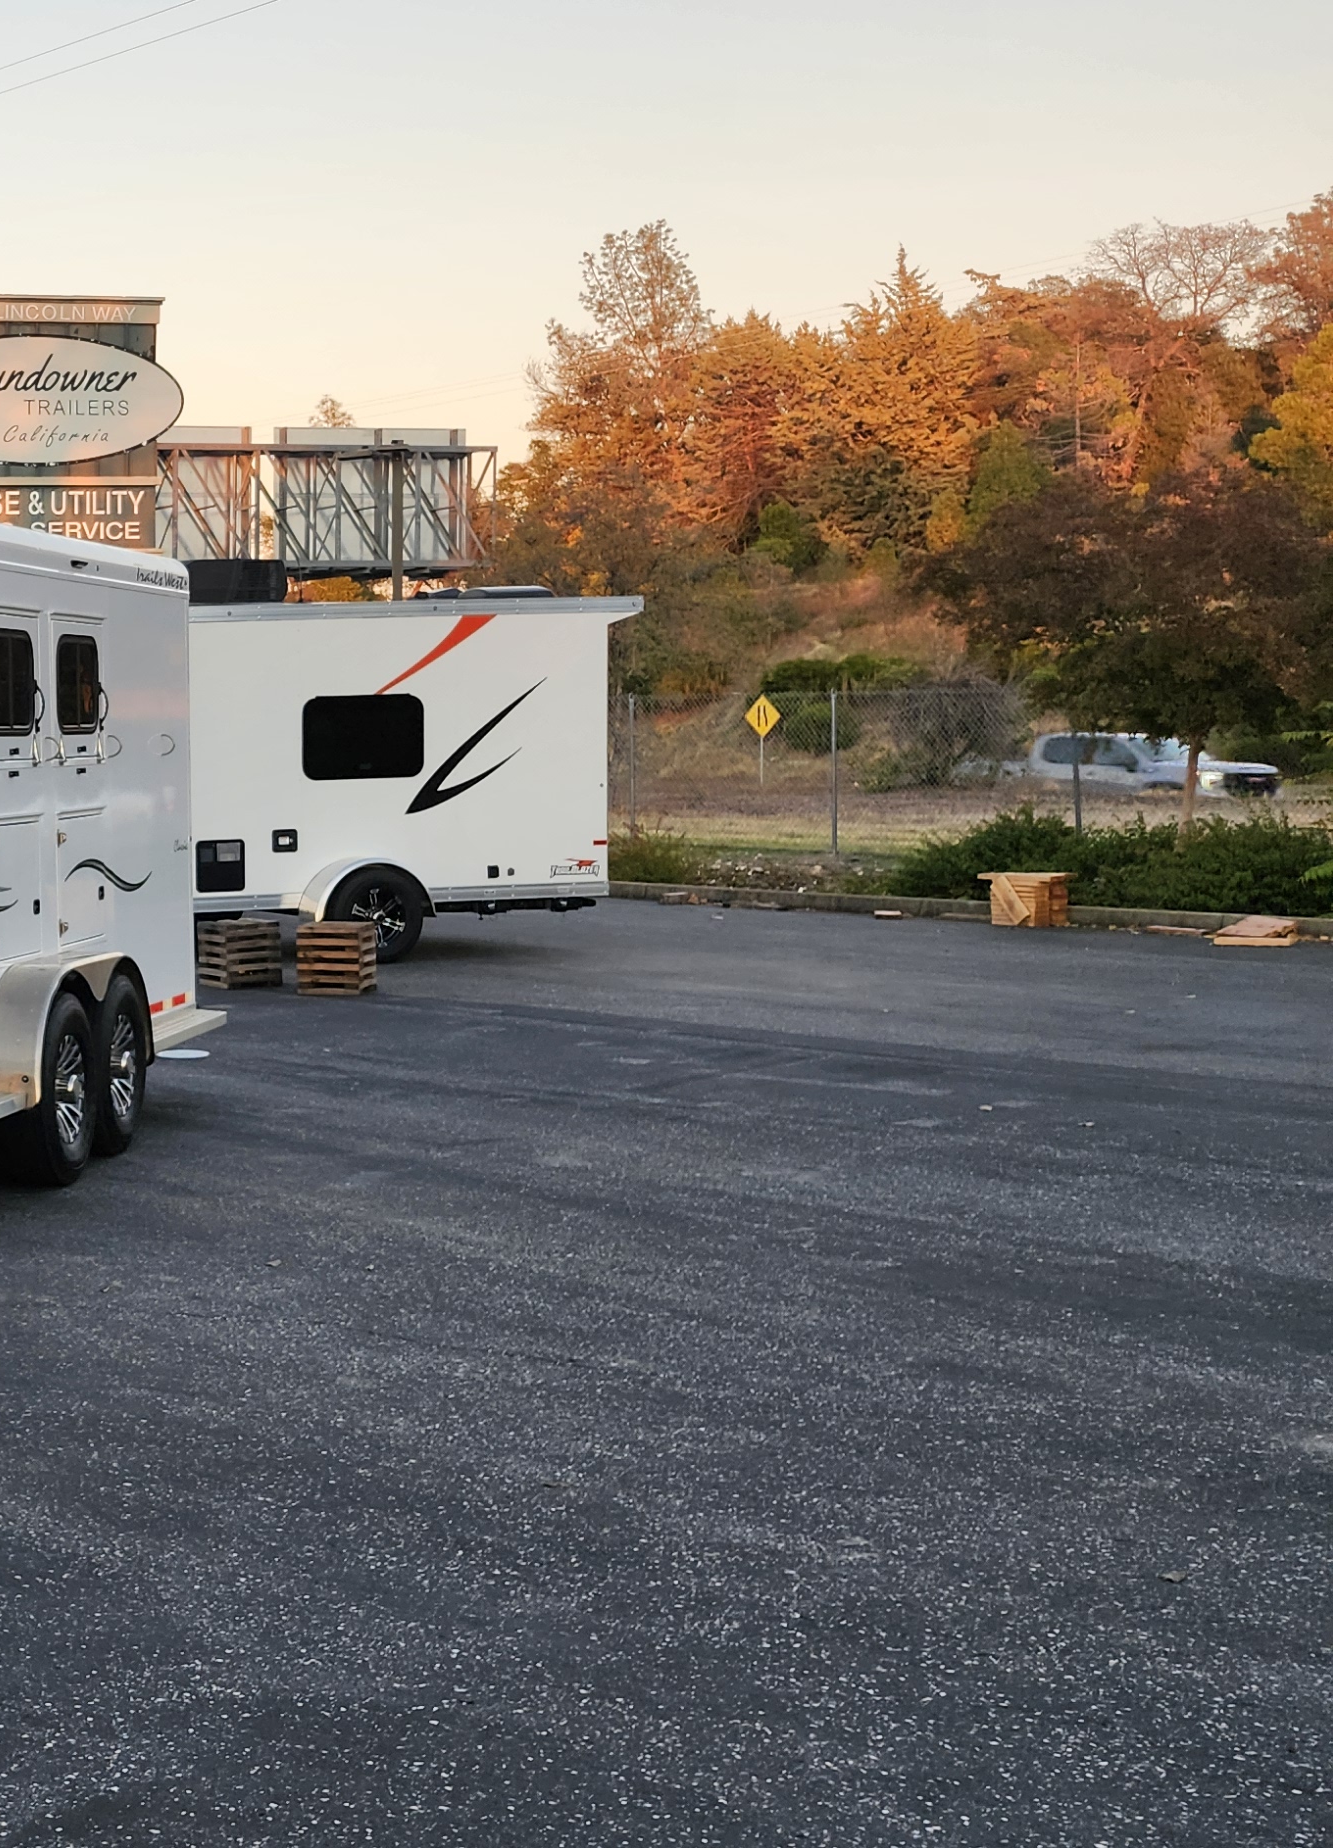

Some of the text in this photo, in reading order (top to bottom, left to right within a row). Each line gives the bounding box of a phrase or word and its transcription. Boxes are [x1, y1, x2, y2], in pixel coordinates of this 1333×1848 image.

[92, 306, 137, 322] WAY
[23, 399, 130, 416] TRAILERS
[3, 425, 109, 448] California
[28, 491, 45, 516] &
[50, 491, 146, 516] UTILITY
[31, 521, 142, 541] SERVICE
